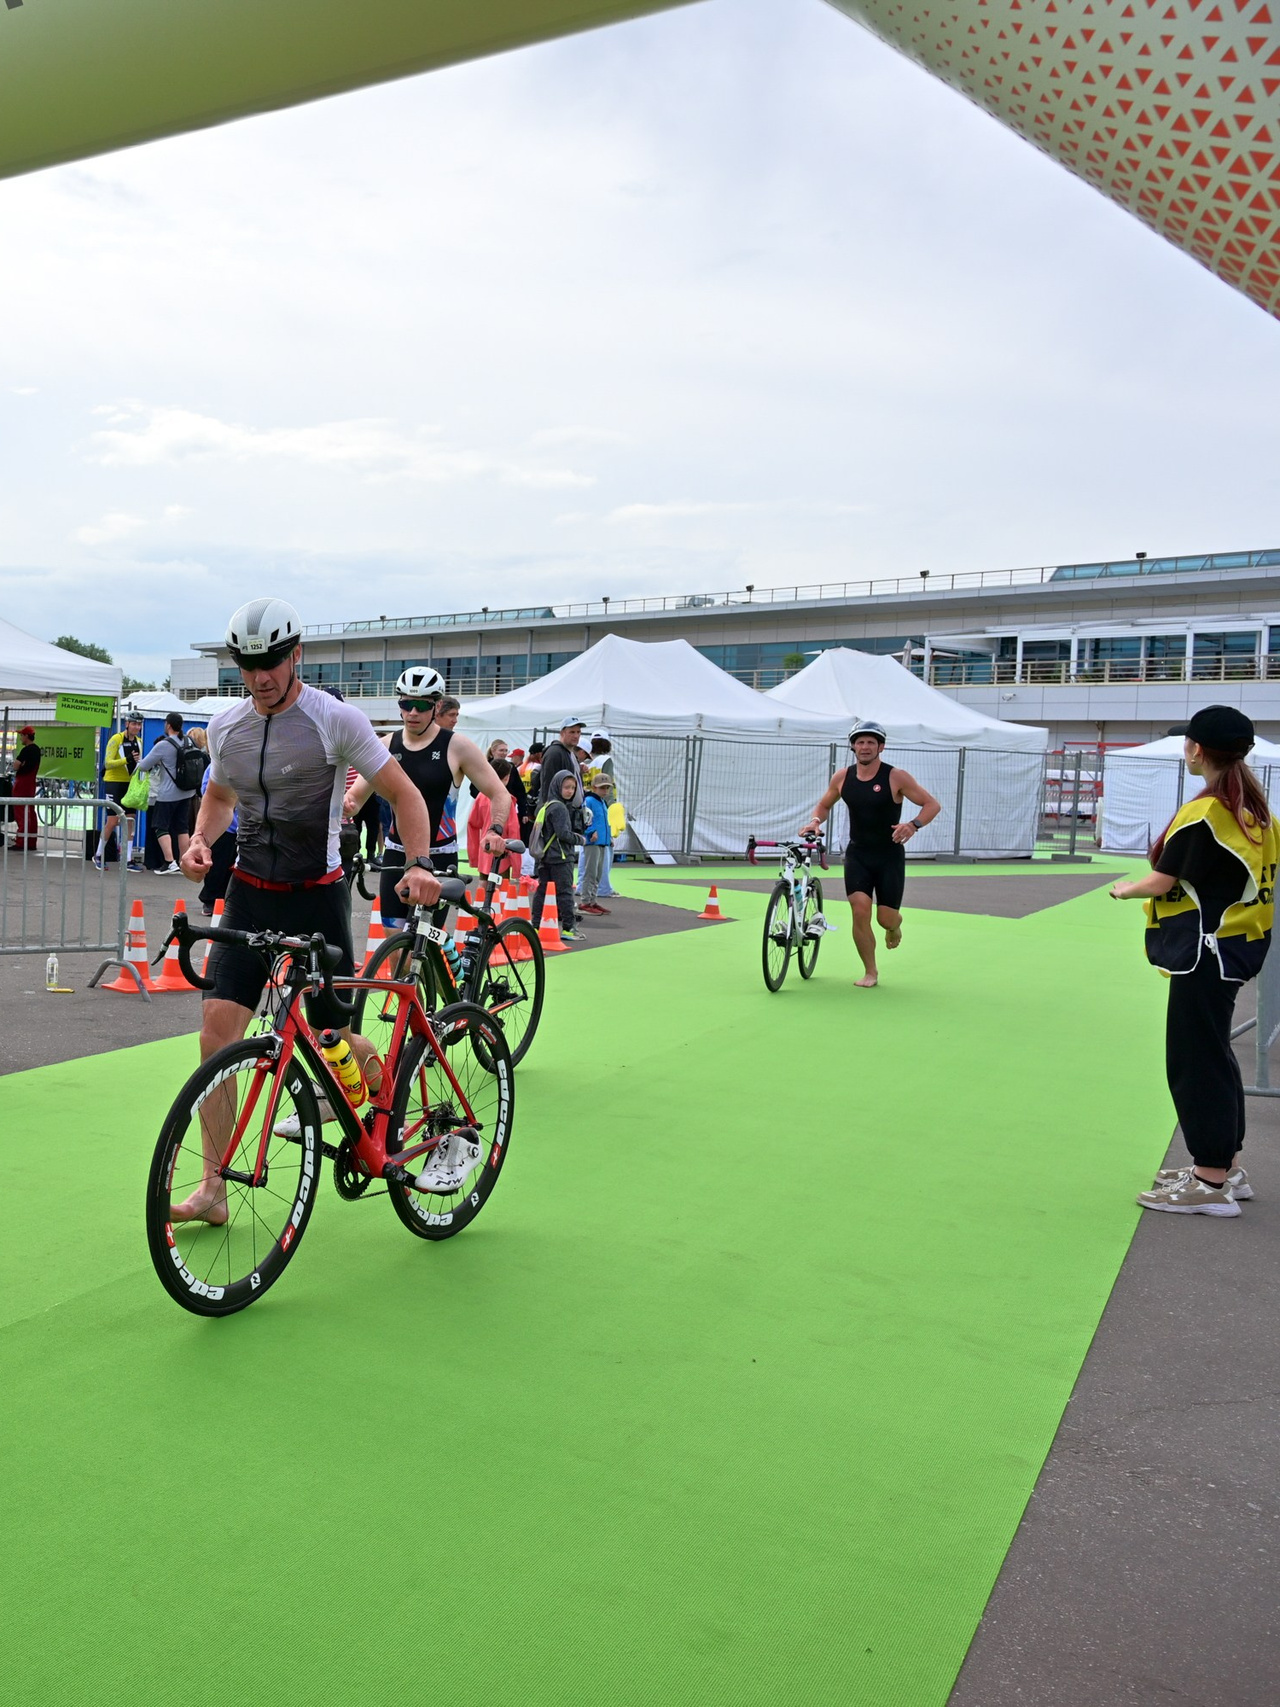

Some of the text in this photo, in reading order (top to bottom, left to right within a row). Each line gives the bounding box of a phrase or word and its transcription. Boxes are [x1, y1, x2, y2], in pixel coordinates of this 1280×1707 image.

[61, 696, 109, 708] ЭСТАФЕТНЫЙ
[61, 703, 108, 715] НАКОПИТЕЛЬ
[40, 746, 55, 758] ФЕТА
[55, 747, 67, 758] ВЕЛ
[73, 747, 85, 759] БЕГ
[190, 1057, 258, 1120] edco
[496, 1059, 510, 1147] edco
[291, 1125, 315, 1230] edco
[407, 1195, 454, 1226] edco
[170, 1247, 225, 1300] edco
